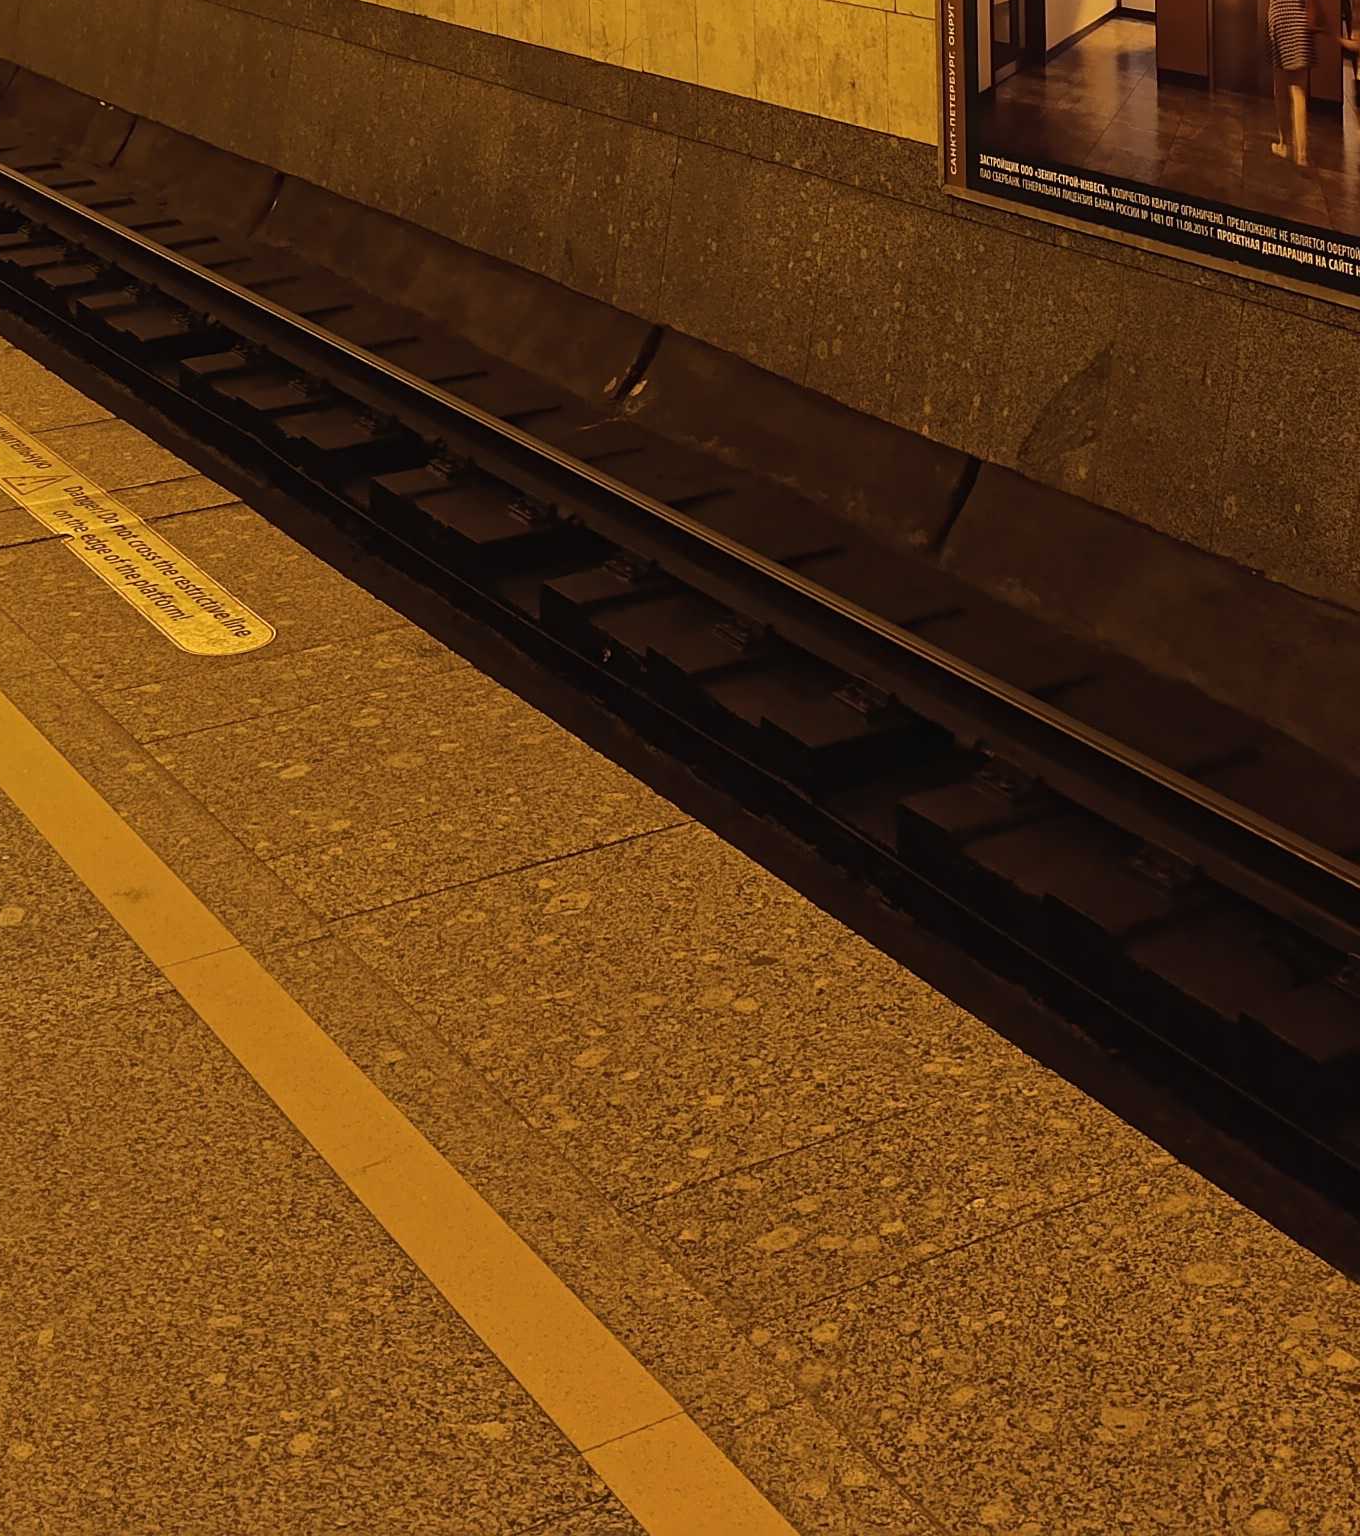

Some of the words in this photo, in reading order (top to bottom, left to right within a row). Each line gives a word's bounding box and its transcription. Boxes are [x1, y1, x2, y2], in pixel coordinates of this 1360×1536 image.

[948, 2, 956, 46] ОКРУГ
[980, 154, 1020, 173] ЗАСТРОЙЩИК
[1021, 164, 1033, 176] ООО
[1111, 187, 1150, 206] КОЛИЧЕСТВО
[1152, 196, 1179, 213] КВАРТИР
[1226, 216, 1277, 240] ПРЕДЛОЖЕНИЕ
[1279, 228, 1289, 243] НЕ
[1290, 232, 1325, 251] ЯВЛЯЕТСЯ
[1217, 229, 1260, 251] ПРОЕКТНАЯ
[1262, 241, 1313, 264] ДЕКЛАРАЦИЯ
[1315, 255, 1326, 269] НА
[1328, 258, 1354, 275] САЙТЕ
[53, 510, 73, 520] on
[65, 519, 88, 533] the
[80, 534, 112, 555] edge
[103, 554, 131, 564] of
[64, 486, 112, 514] Danger!
[97, 512, 119, 524] Do
[110, 524, 140, 540] not
[128, 540, 162, 561] cross
[153, 560, 178, 576] the
[169, 575, 230, 620] restrictive
[221, 617, 251, 637] line
[115, 564, 141, 580] the
[124, 579, 194, 621] platform!
